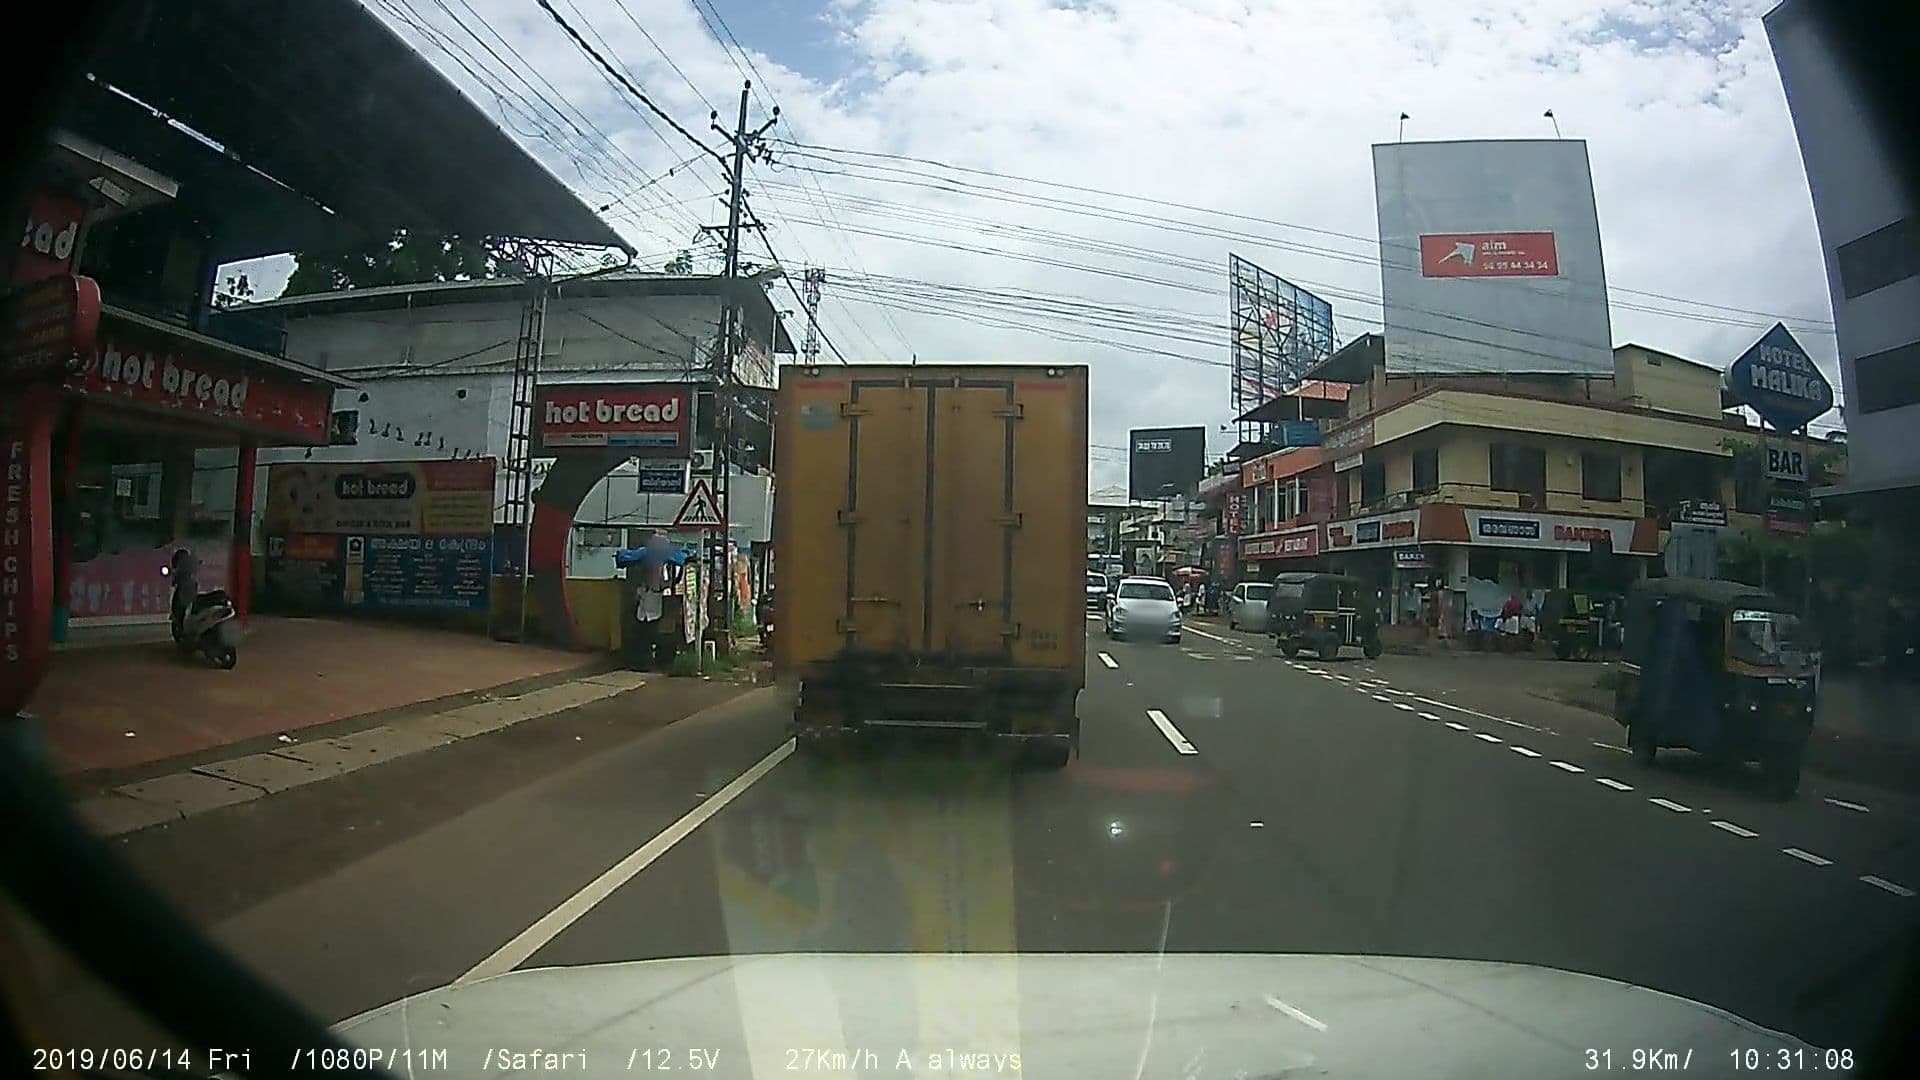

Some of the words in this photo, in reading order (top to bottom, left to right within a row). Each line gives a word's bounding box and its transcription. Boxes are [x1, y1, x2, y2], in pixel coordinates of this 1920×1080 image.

[101, 343, 155, 390] hot
[162, 353, 248, 409] bread
[1760, 344, 1810, 372] HOTEL
[1751, 364, 1821, 401] MALIKA
[545, 400, 590, 424] hot
[596, 398, 680, 423] bread
[1768, 449, 1803, 475] BAR
[4, 440, 24, 545] FRESH
[342, 480, 364, 496] hot
[367, 480, 408, 496] bread
[1229, 496, 1240, 533] HOTEL
[2, 555, 19, 663] CHIPS
